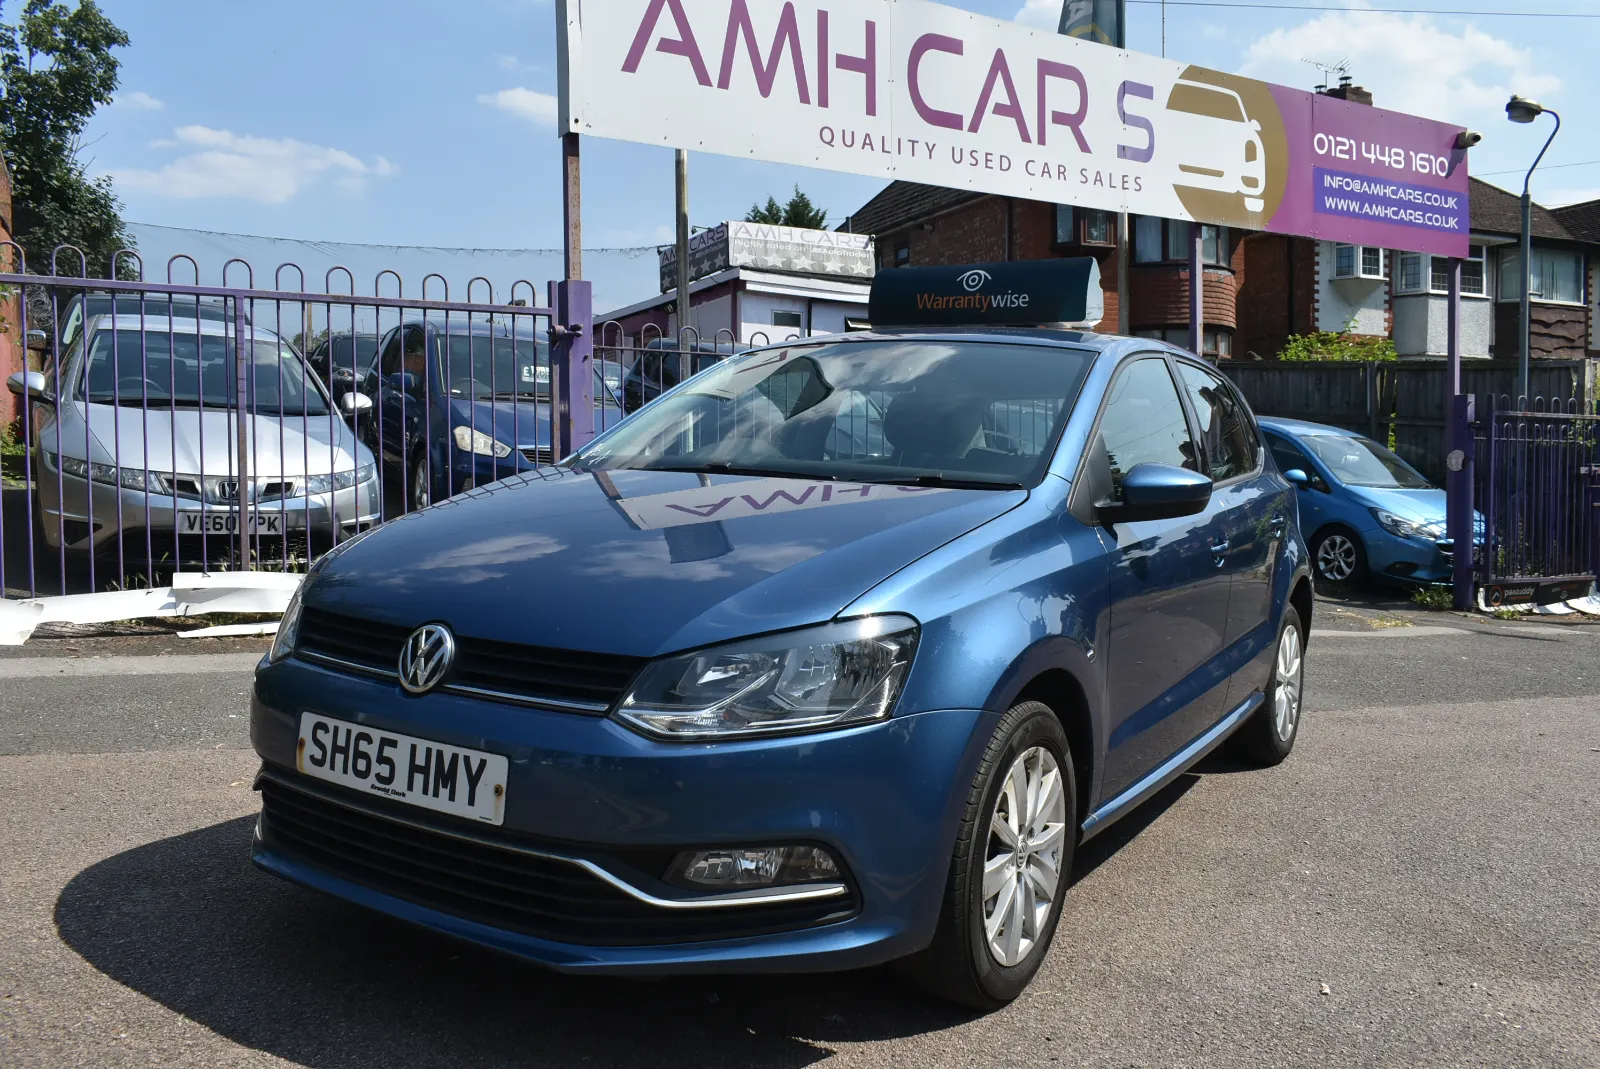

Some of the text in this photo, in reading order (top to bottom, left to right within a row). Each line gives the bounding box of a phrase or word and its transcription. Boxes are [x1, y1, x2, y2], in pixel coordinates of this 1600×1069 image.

[621, 0, 876, 117] AMH
[819, 126, 1143, 192] QUALITY USED CAR SALES
[1313, 132, 1448, 177] 0121 448 1610
[1324, 174, 1458, 210] INFO@AMHCARS.CO.UK
[1324, 196, 1459, 230] WWW.AMHCARS.CO.UK
[689, 226, 725, 251] CARS
[734, 239, 764, 248] Highly
[766, 243, 792, 251] rated
[735, 223, 869, 249] AMH CARS
[916, 290, 1029, 312] Warrantywise
[187, 514, 237, 532] VE60
[309, 721, 487, 807] SH65 HMY
